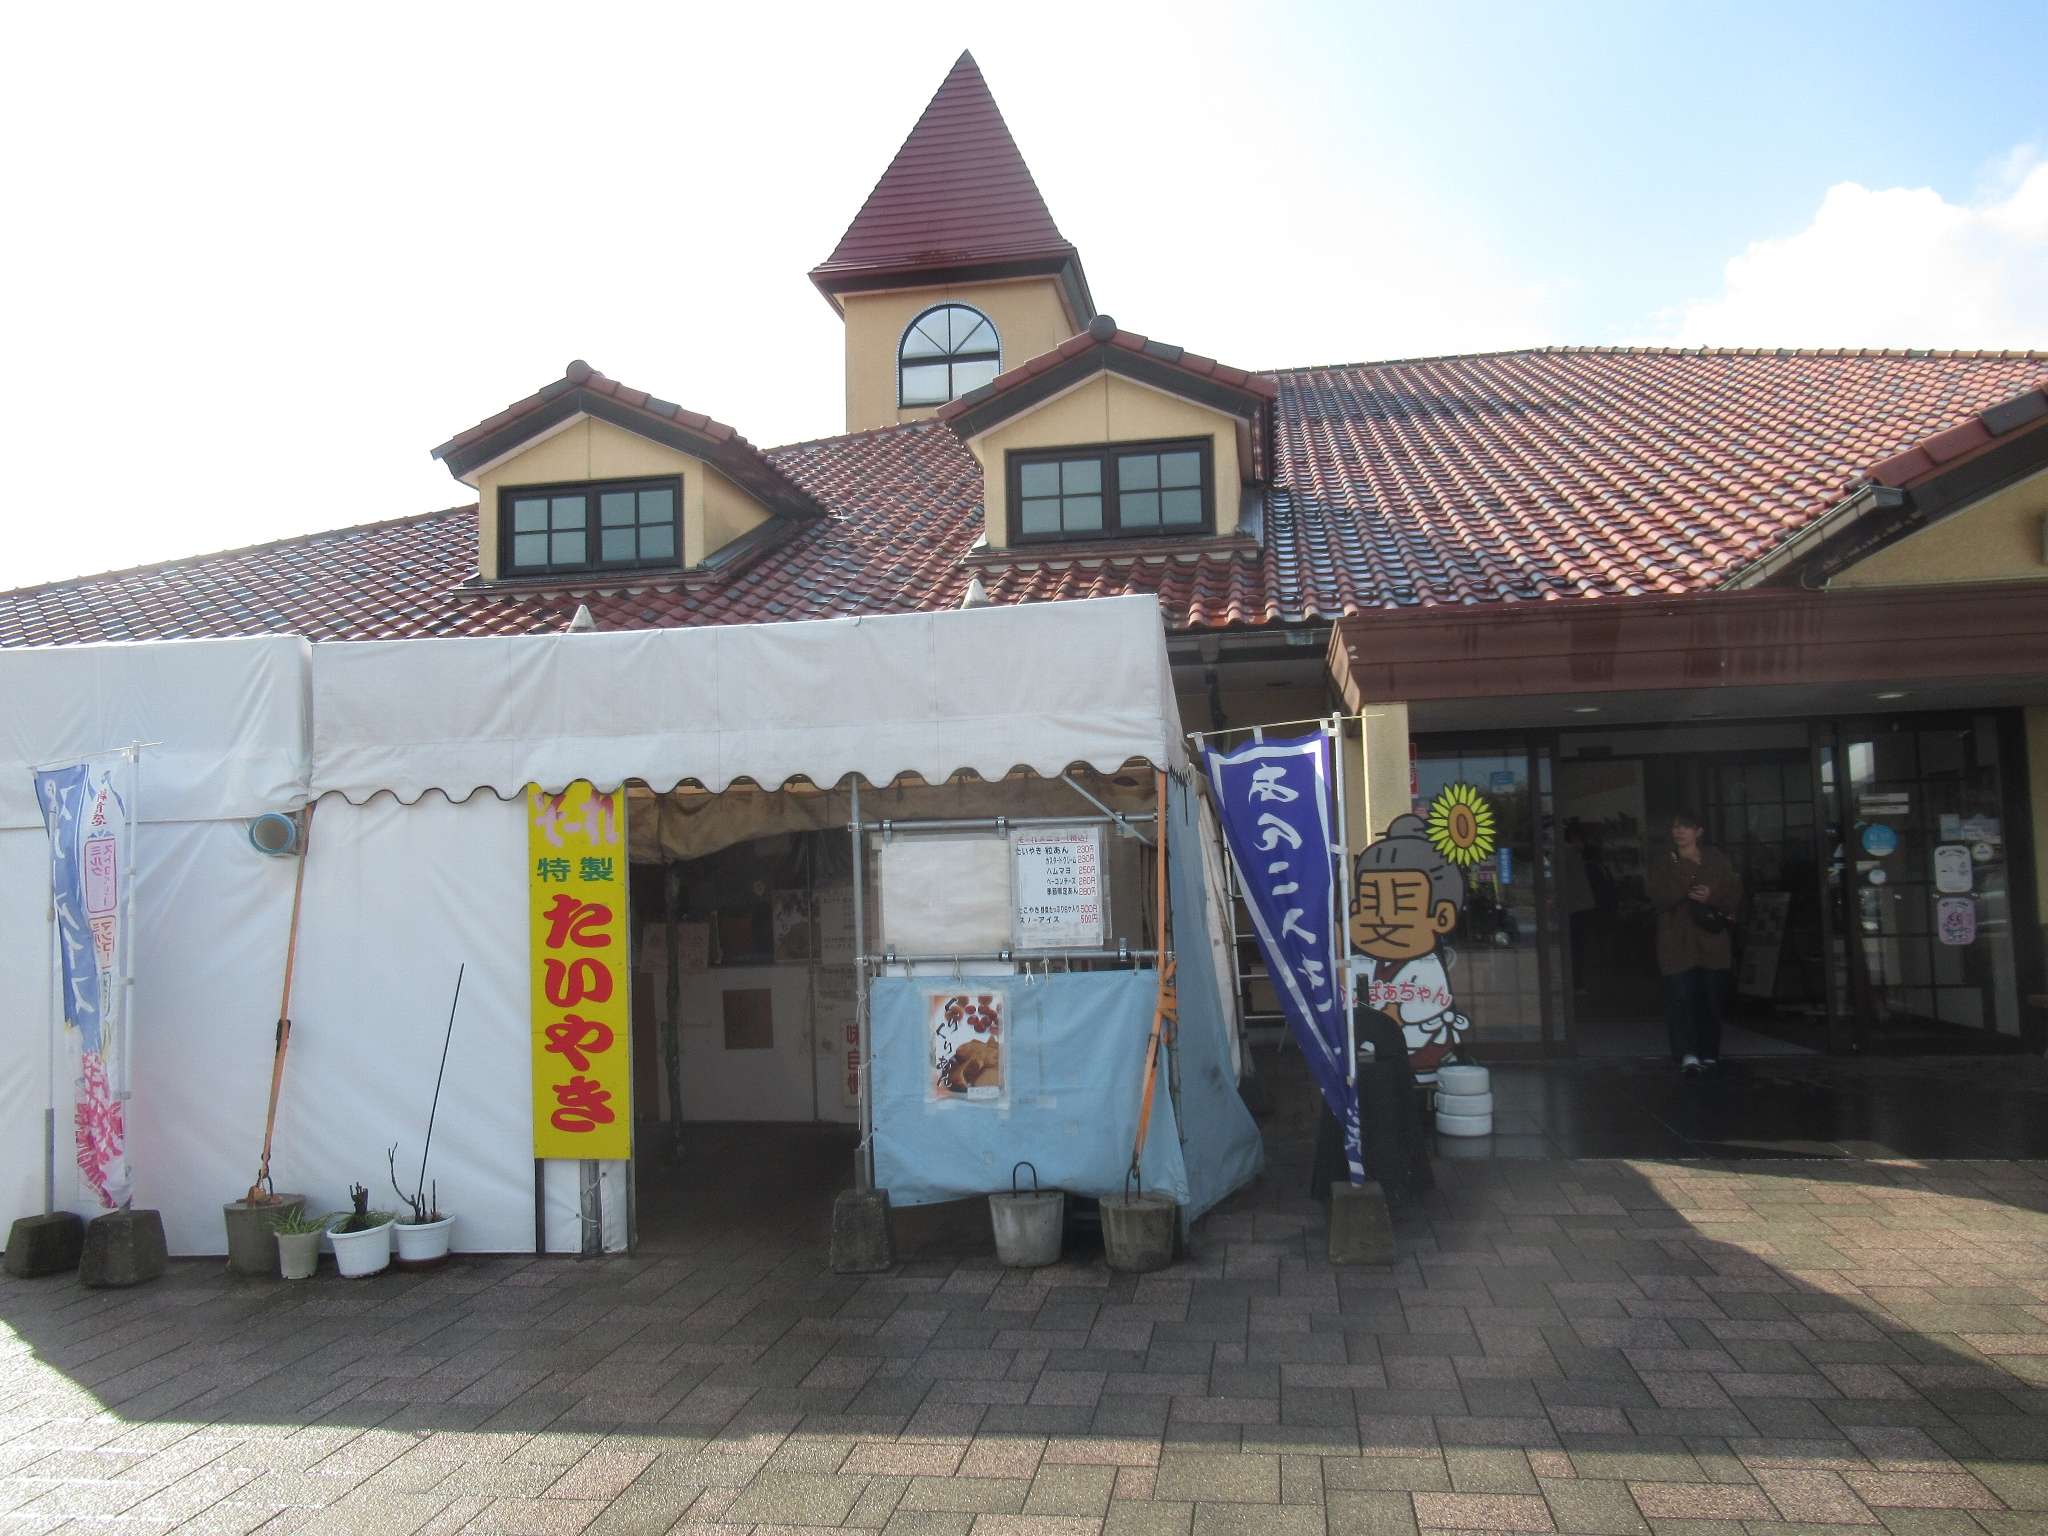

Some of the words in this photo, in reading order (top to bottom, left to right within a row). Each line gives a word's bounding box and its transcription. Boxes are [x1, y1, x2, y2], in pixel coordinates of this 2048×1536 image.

[537, 856, 615, 883] 特製
[1019, 917, 1060, 925] スノーアイス
[544, 893, 615, 1133] たいやき
